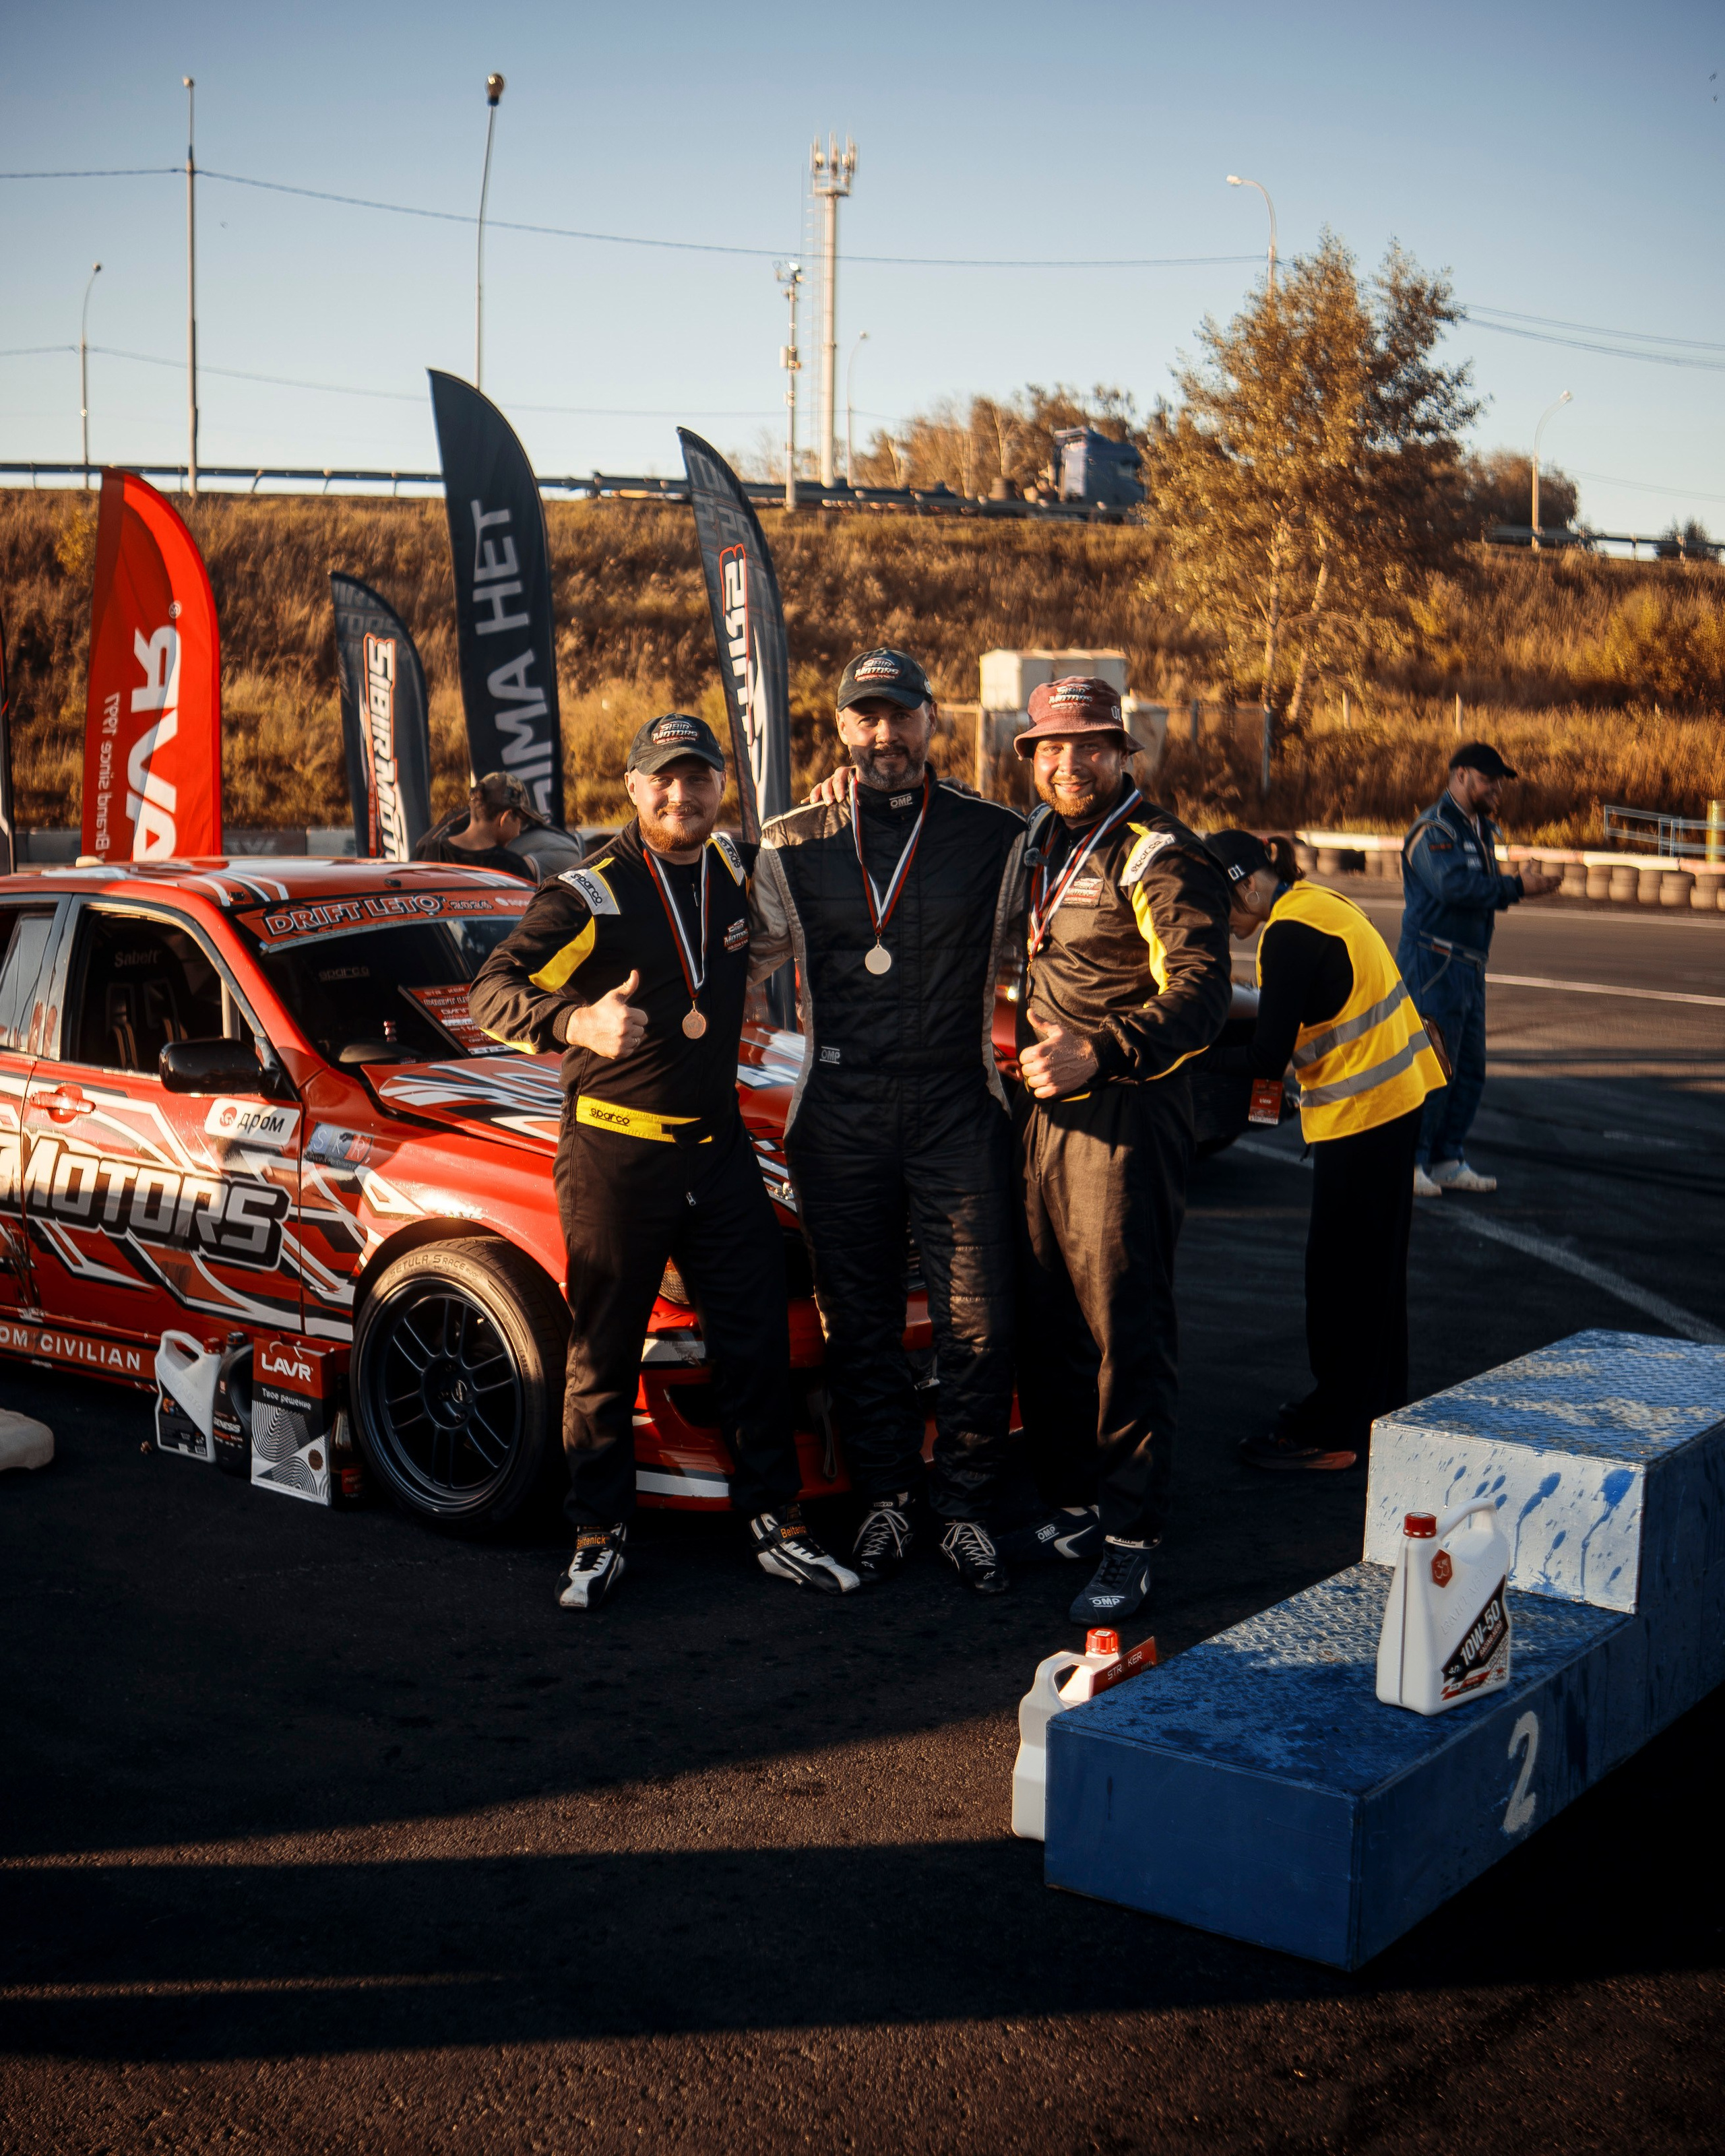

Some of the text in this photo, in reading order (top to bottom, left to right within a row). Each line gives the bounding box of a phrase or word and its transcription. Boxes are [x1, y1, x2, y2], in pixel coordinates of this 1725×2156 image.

[652, 730, 697, 741] MOTORS
[890, 797, 912, 806] OMP
[1130, 839, 1164, 873] sparco
[1228, 864, 1245, 881] 01
[570, 873, 603, 906] sparco
[267, 901, 360, 937] DRIFT
[365, 895, 441, 918] LETO
[821, 1049, 840, 1061] OMP
[238, 1109, 285, 1133] дром
[590, 1108, 630, 1125] sparco
[0, 1135, 277, 1253] MOTORS
[40, 1333, 140, 1371] CIVILIAN
[261, 1352, 312, 1383] LAVR
[262, 1388, 312, 1412] Твое решение
[1037, 1525, 1056, 1540] OMP
[1092, 1597, 1121, 1607] OMP
[1460, 1600, 1501, 1666] 10W-50
[1503, 1710, 1539, 1834] 2
